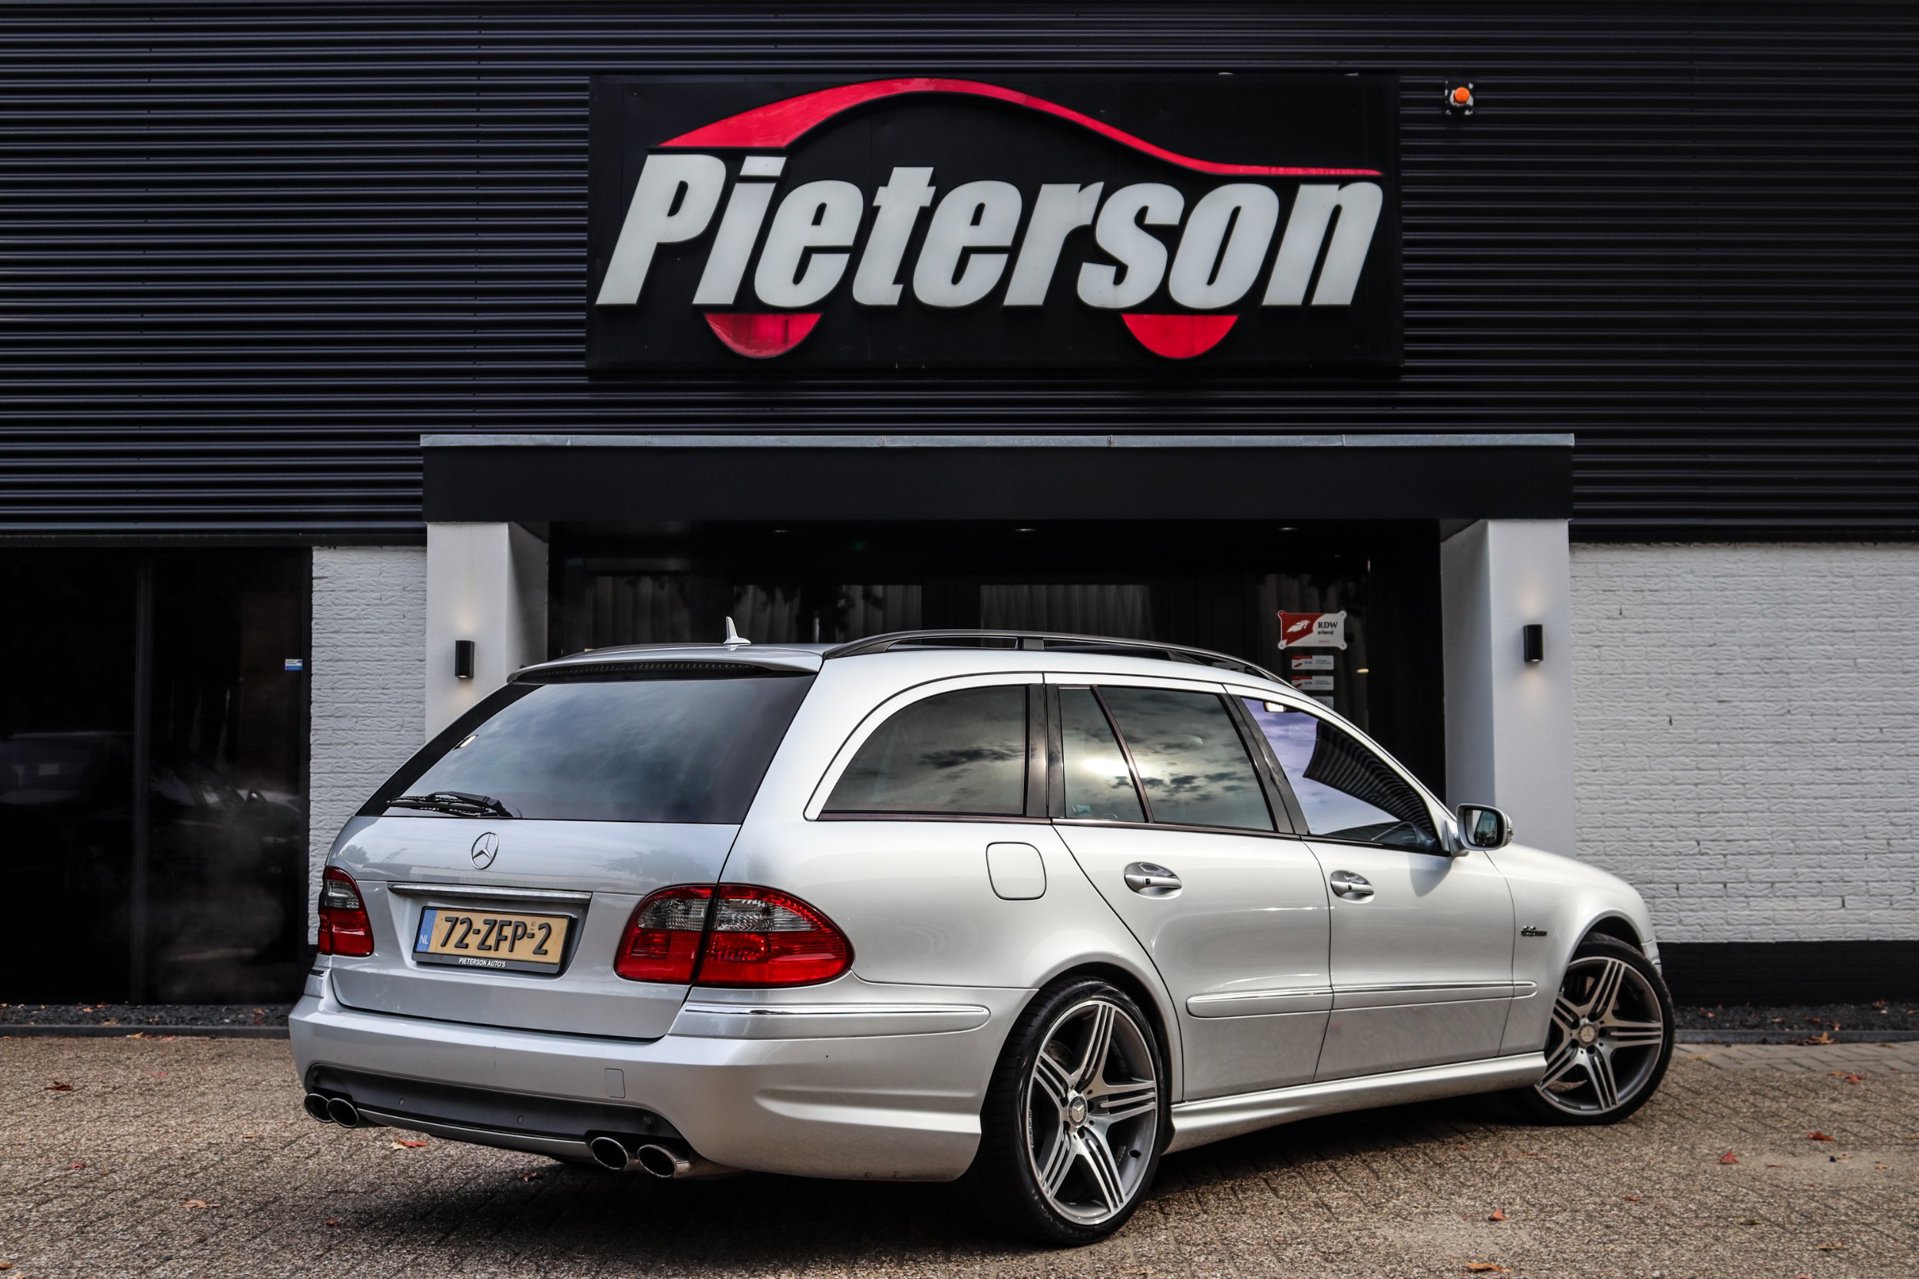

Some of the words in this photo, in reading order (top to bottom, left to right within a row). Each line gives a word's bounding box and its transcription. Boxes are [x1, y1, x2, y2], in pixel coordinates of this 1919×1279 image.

[595, 154, 1384, 310] Pieterson
[1317, 621, 1338, 629] RDW
[419, 934, 429, 944] NL
[440, 916, 552, 955] 72-ZFP-2
[458, 957, 487, 966] PIETERSON
[486, 960, 507, 968] AUTO'S
